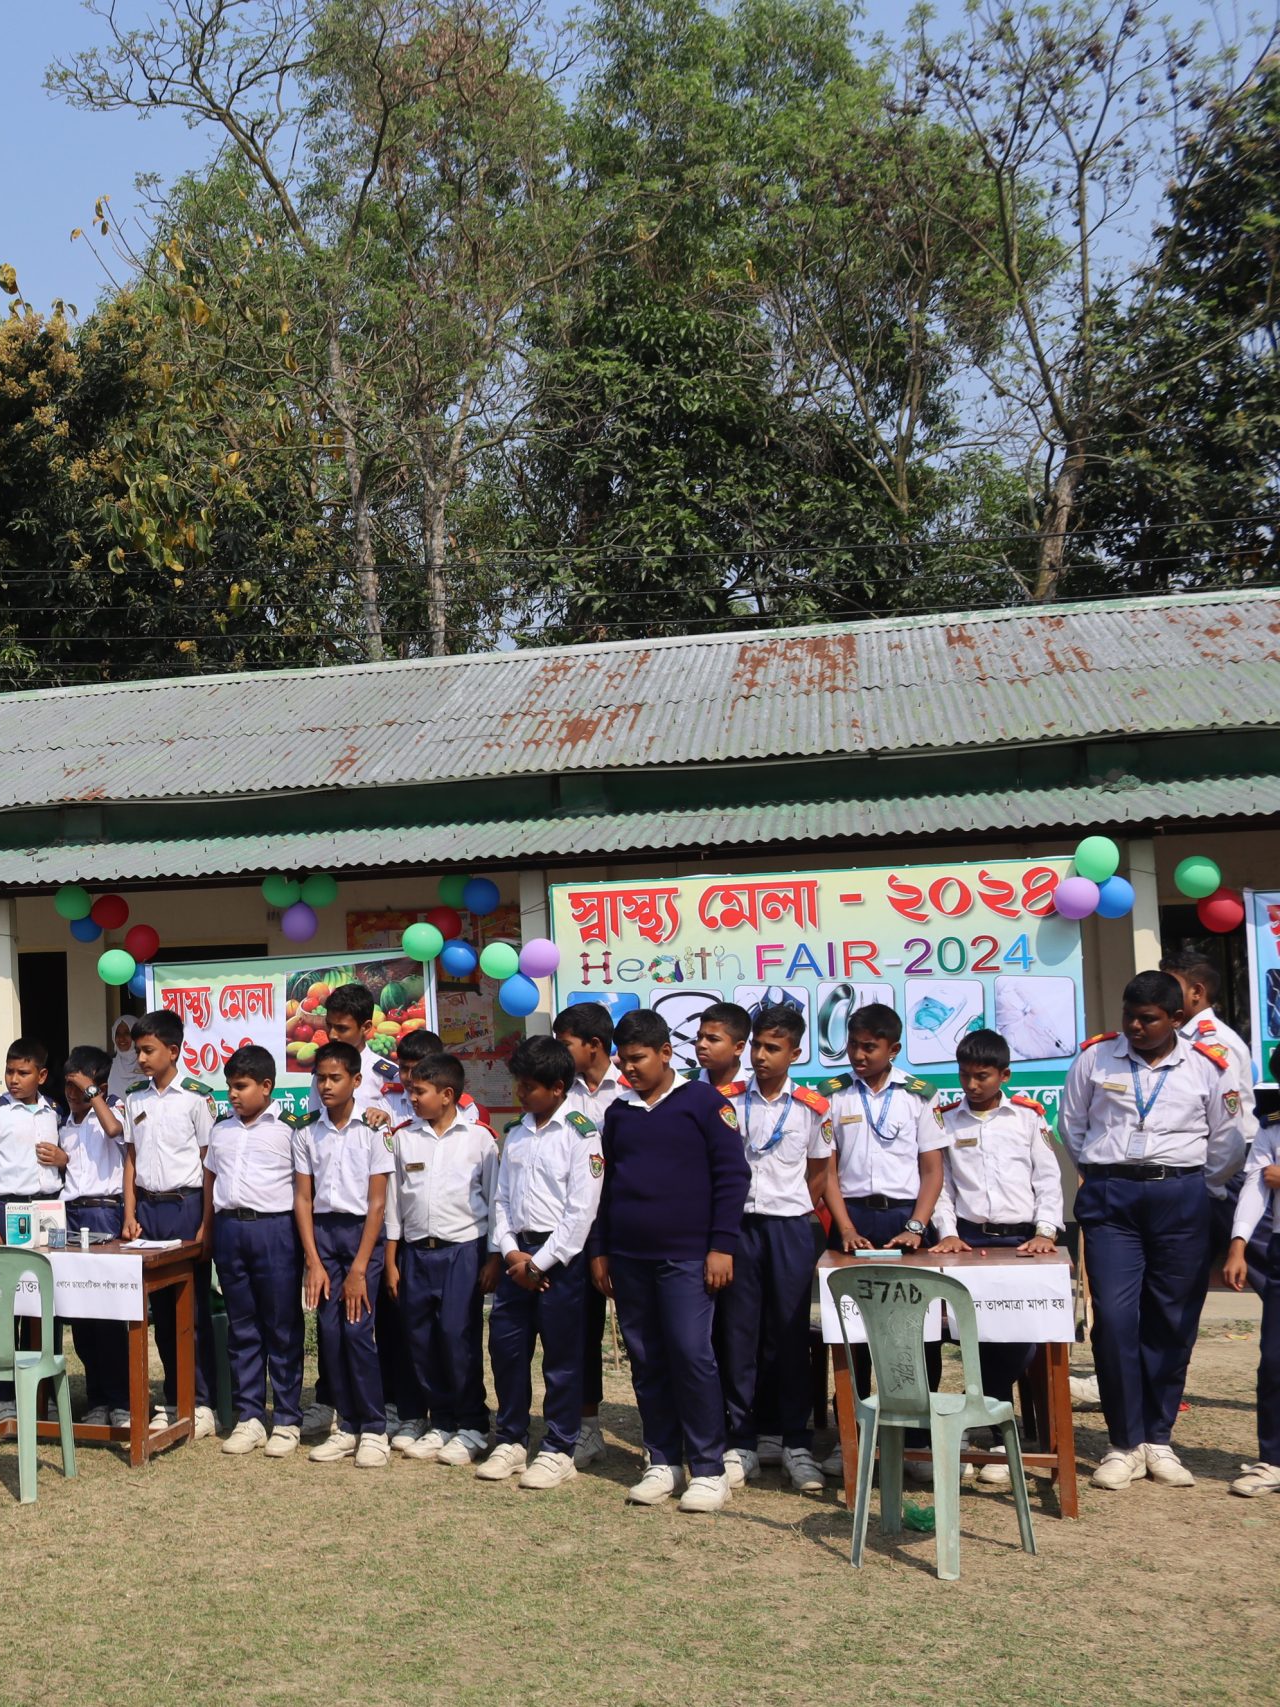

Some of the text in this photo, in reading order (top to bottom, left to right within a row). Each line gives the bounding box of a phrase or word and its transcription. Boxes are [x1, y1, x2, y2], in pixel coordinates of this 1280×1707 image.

[568, 887, 681, 945] স্বাস্থ্য
[698, 880, 820, 932] মেলা
[886, 866, 1060, 923] ২০২৪
[579, 945, 746, 985] Health
[219, 983, 274, 1020] মেলা
[183, 1037, 254, 1077] ২০২
[985, 1300, 1024, 1311] তাপমাত্রা
[1027, 1299, 1048, 1310] মাপা
[1051, 1298, 1065, 1310] হয়
